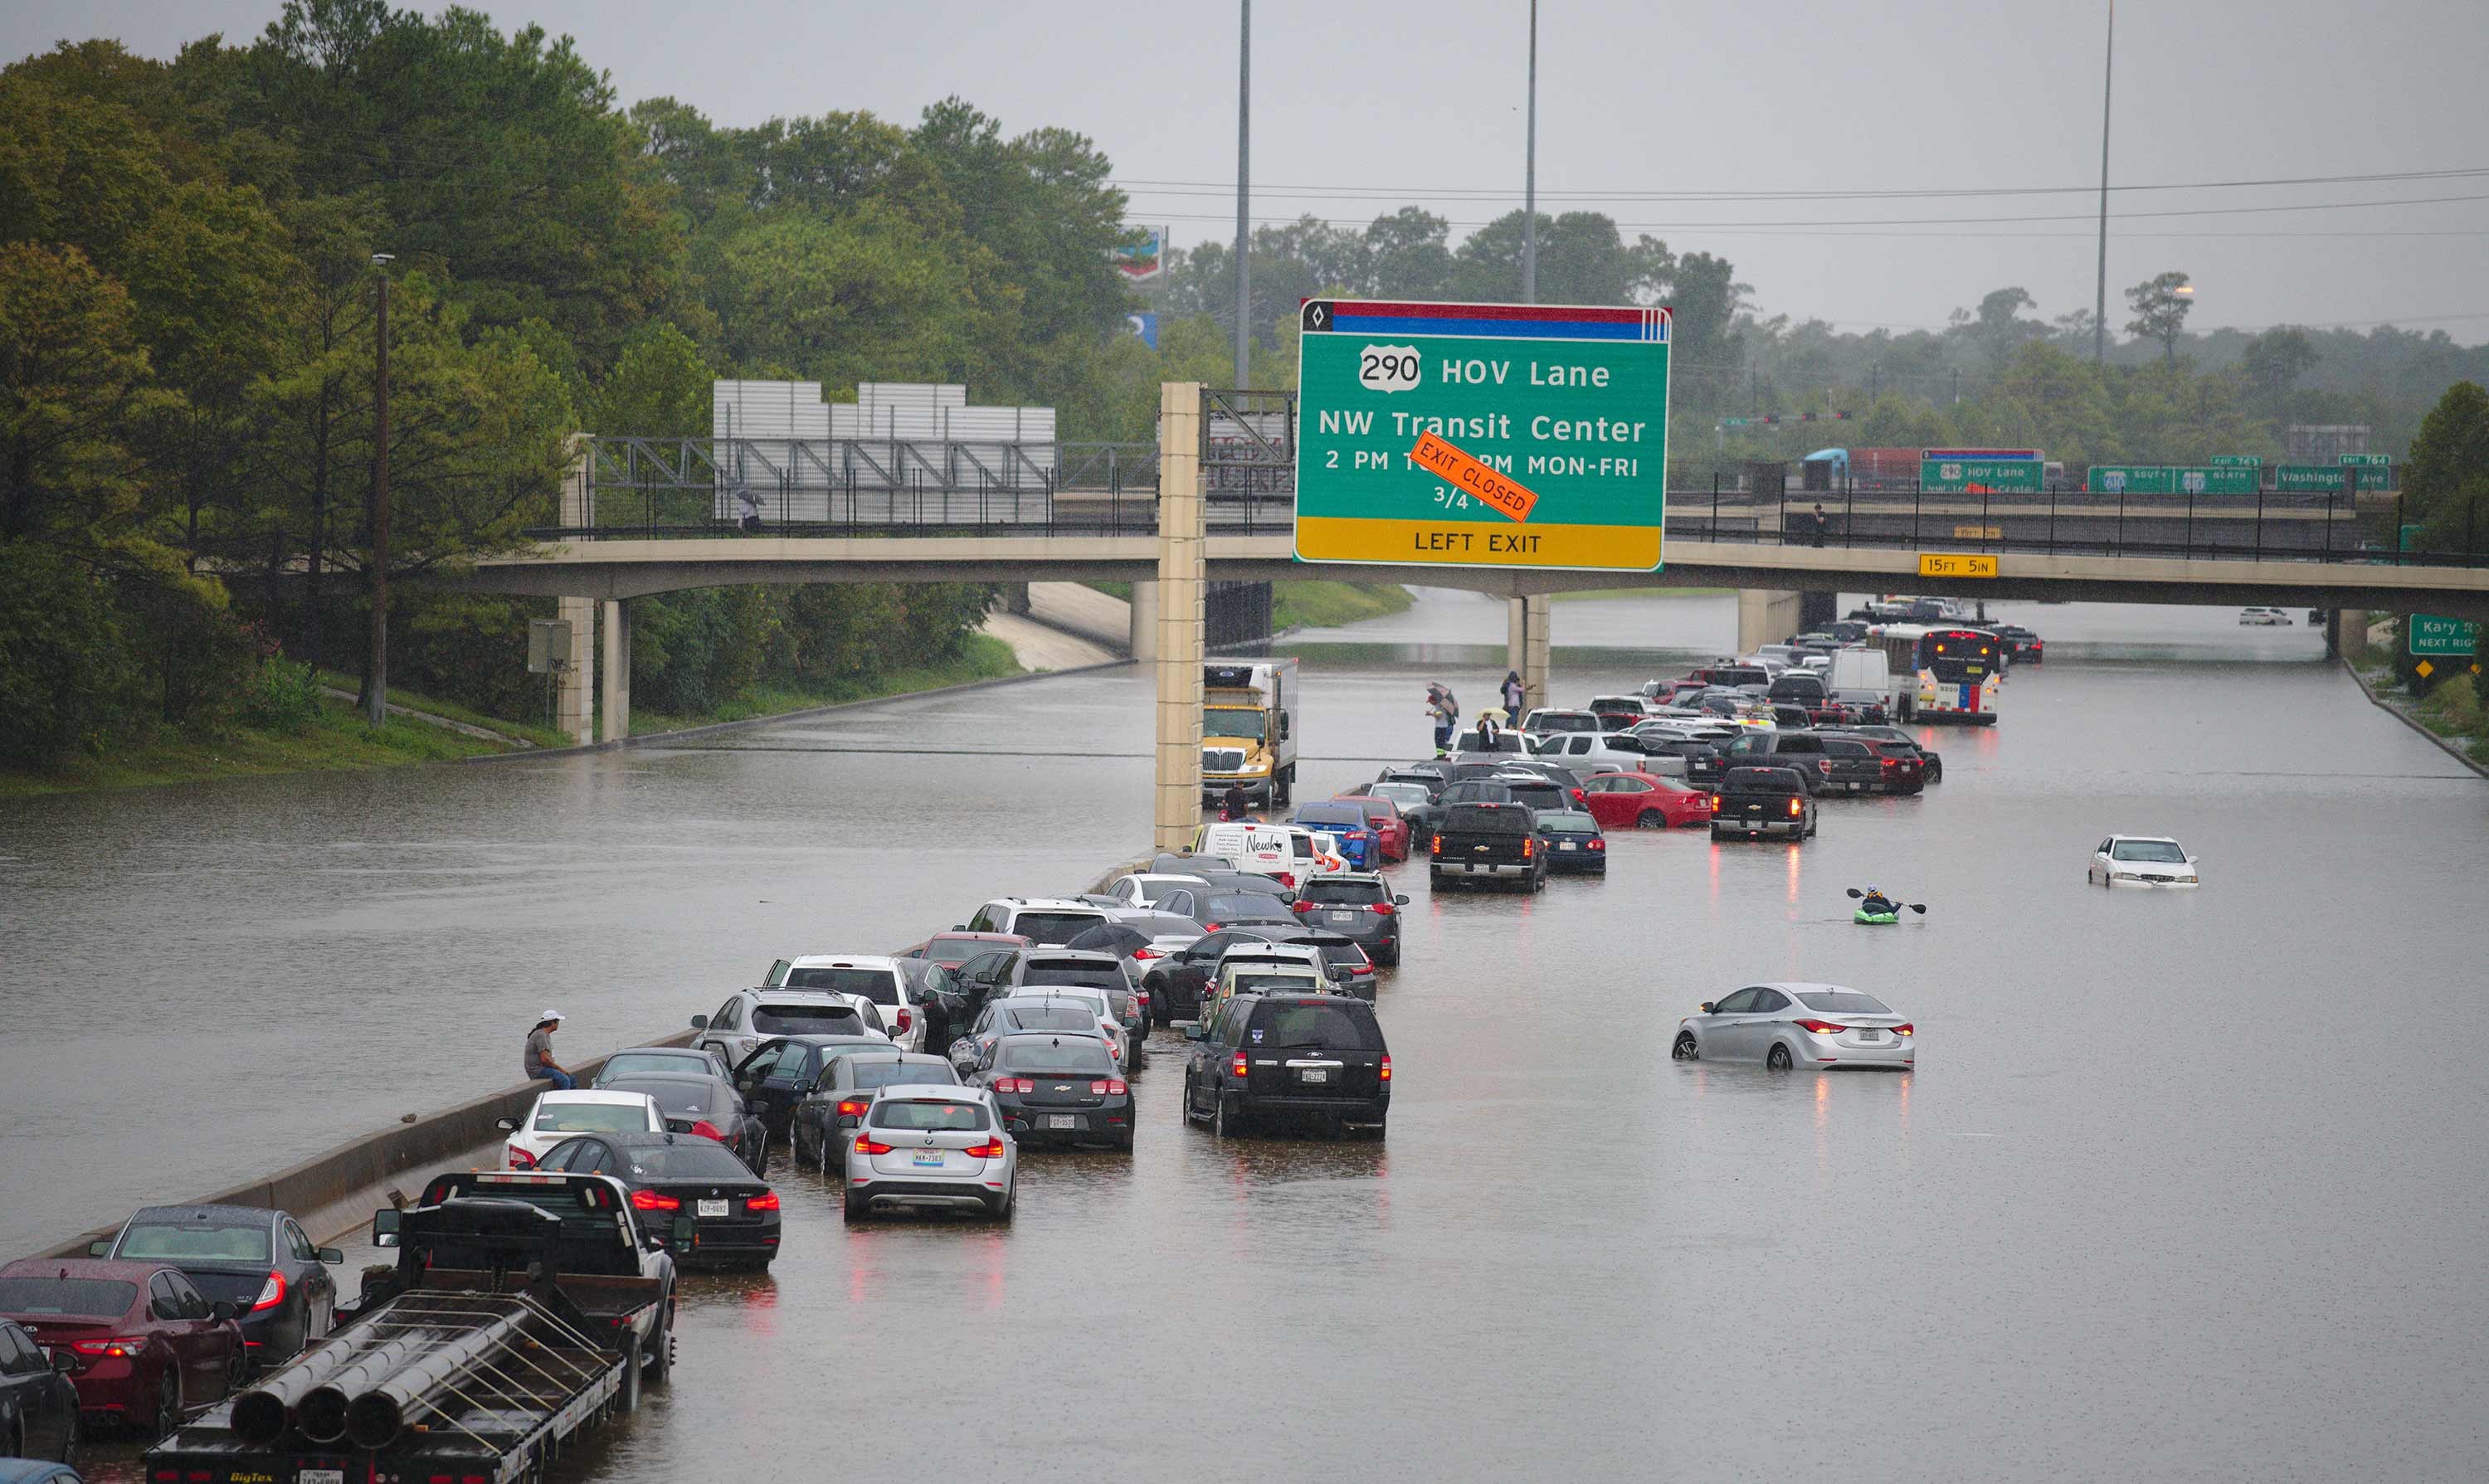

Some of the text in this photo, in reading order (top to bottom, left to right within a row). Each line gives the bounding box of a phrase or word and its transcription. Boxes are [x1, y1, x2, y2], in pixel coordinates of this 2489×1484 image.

[1362, 354, 1610, 387] 290 HOV Lane
[1319, 410, 1646, 443] NW Transit Center
[1326, 450, 1638, 477] 2 PM T PM MON-FRI
[2365, 456, 2385, 465] 764
[1420, 442, 1526, 511] EXIT CLOSED
[1968, 467, 1990, 478] HOV
[1997, 467, 2024, 478] Lane
[2361, 474, 2384, 484] Ave
[2106, 475, 2126, 489] 610
[1434, 486, 1469, 509] 3/4
[1415, 533, 1542, 553] LEFT EXIT
[1929, 559, 1989, 572] 15FT 5IN
[2423, 621, 2457, 635] Katy
[2418, 638, 2447, 647] NEXT
[230, 1472, 273, 1483] BigTex
